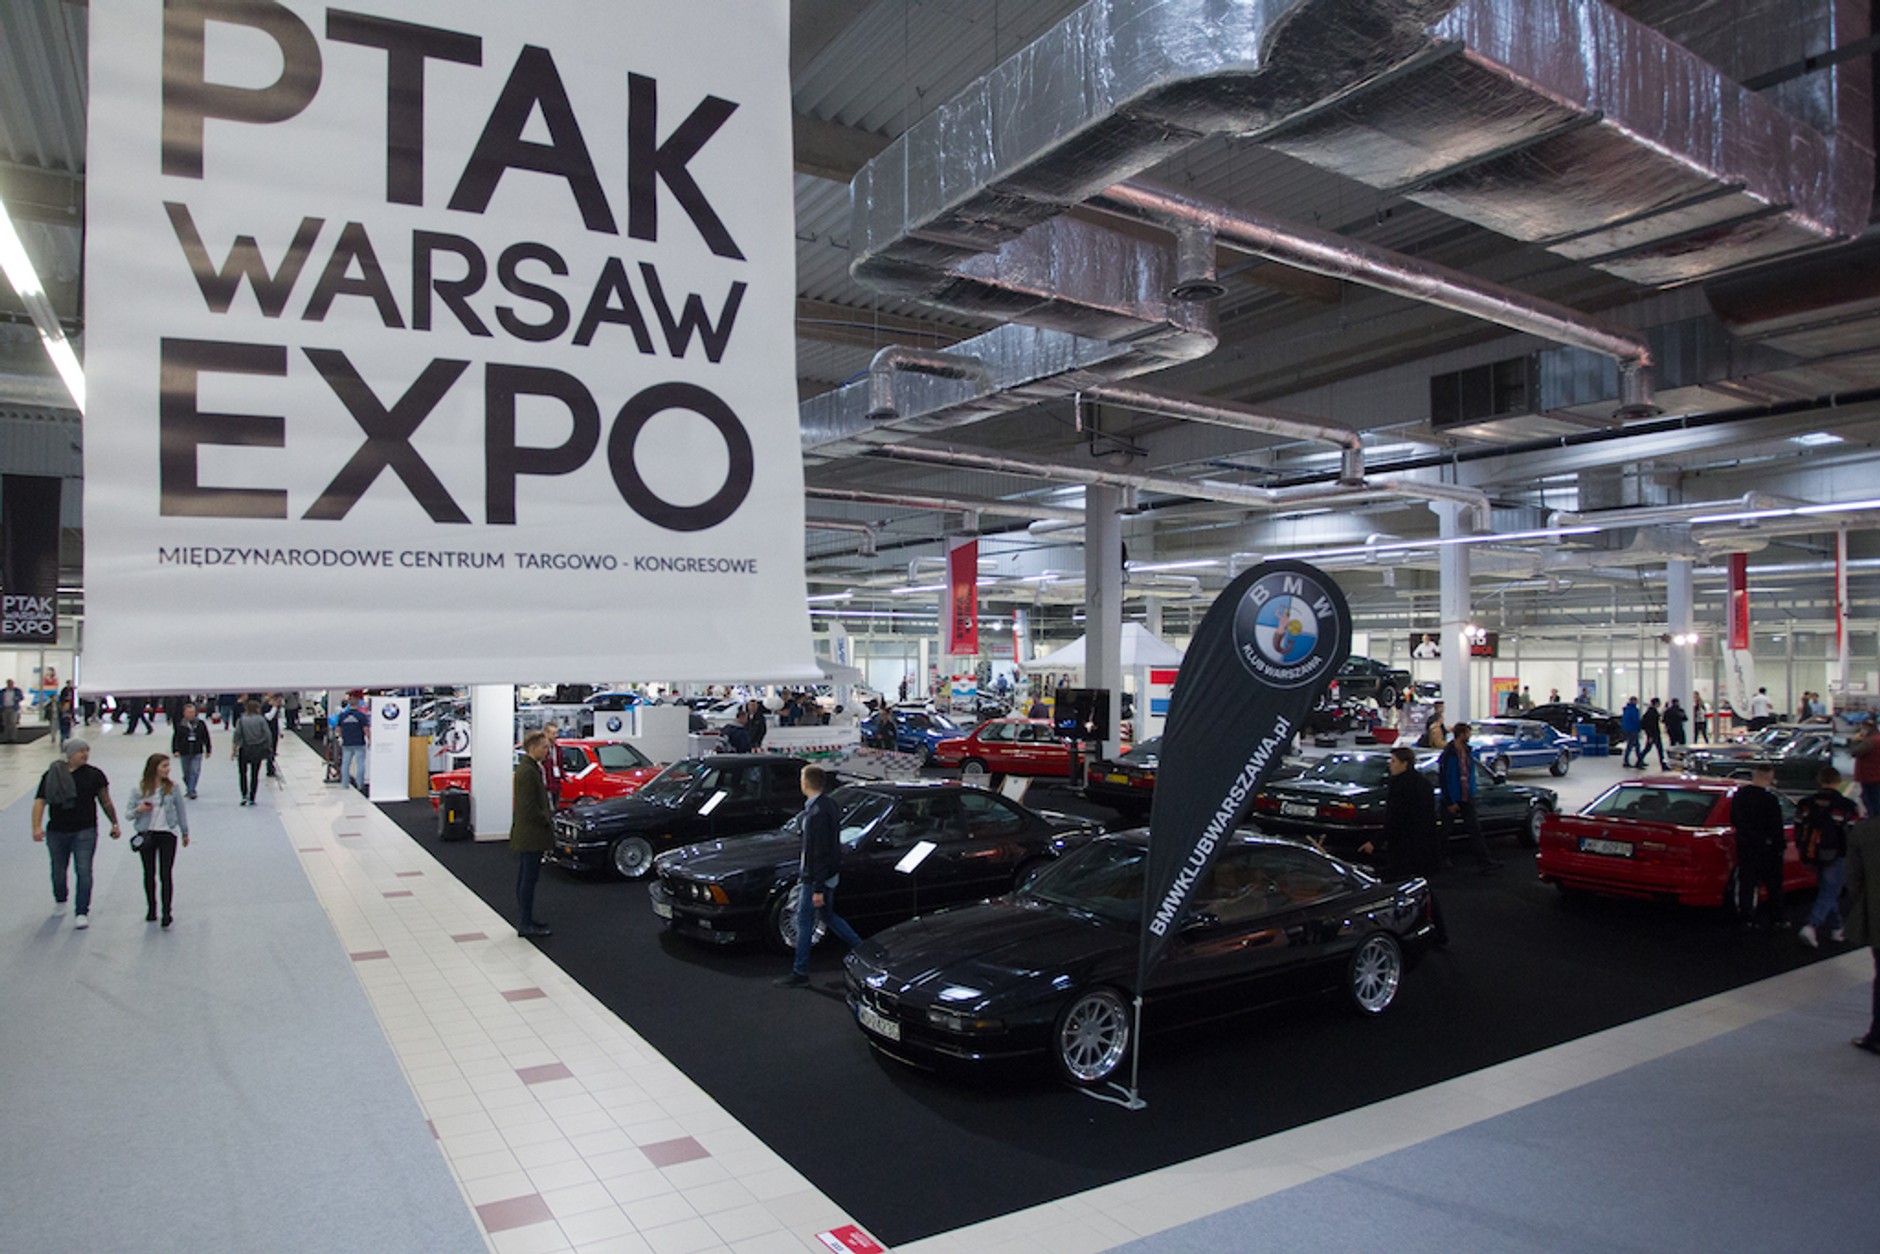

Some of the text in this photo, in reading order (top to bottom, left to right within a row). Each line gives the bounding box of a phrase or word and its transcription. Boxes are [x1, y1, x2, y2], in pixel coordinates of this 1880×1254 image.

[161, 0, 748, 261] PTAK
[162, 201, 749, 364] WARSAW
[159, 337, 755, 533] EXPO
[158, 546, 394, 568] MIĘDZYNARODOWE
[399, 550, 506, 569] CENTRUM
[515, 552, 618, 571] TARGOWO
[634, 555, 758, 574] KONGRESOWE
[3, 595, 54, 611] PTAK
[1249, 576, 1334, 619] BMW
[2, 620, 54, 635] EXPO
[1242, 642, 1324, 680] KLUB WARSZAWA
[1149, 714, 1292, 938] BMWKLUBWARSZAWA.pl
